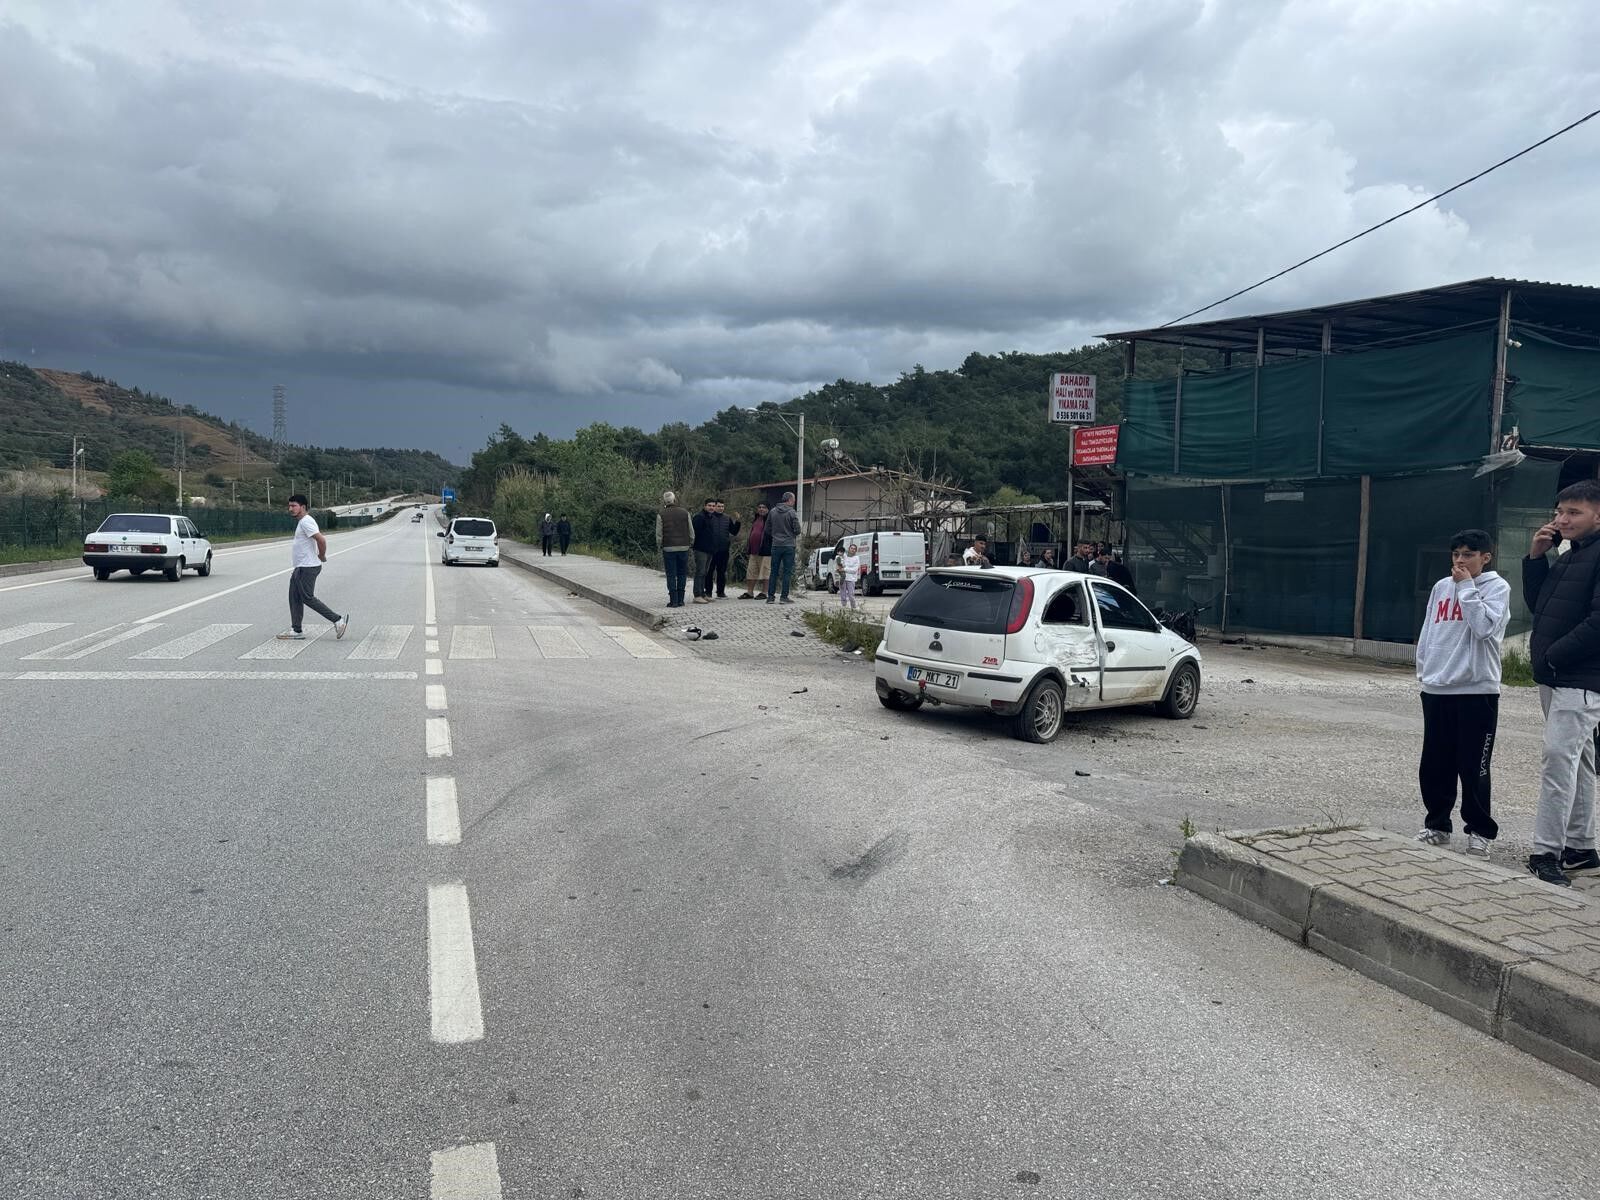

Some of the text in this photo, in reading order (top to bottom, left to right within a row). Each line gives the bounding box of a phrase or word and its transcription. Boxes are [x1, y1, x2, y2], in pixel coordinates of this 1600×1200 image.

[1060, 375, 1090, 387] BAHADIR
[1074, 388, 1094, 399] KOLTUK
[1058, 399, 1078, 410] YIKAMA
[912, 668, 957, 687] 07 MKT 21
